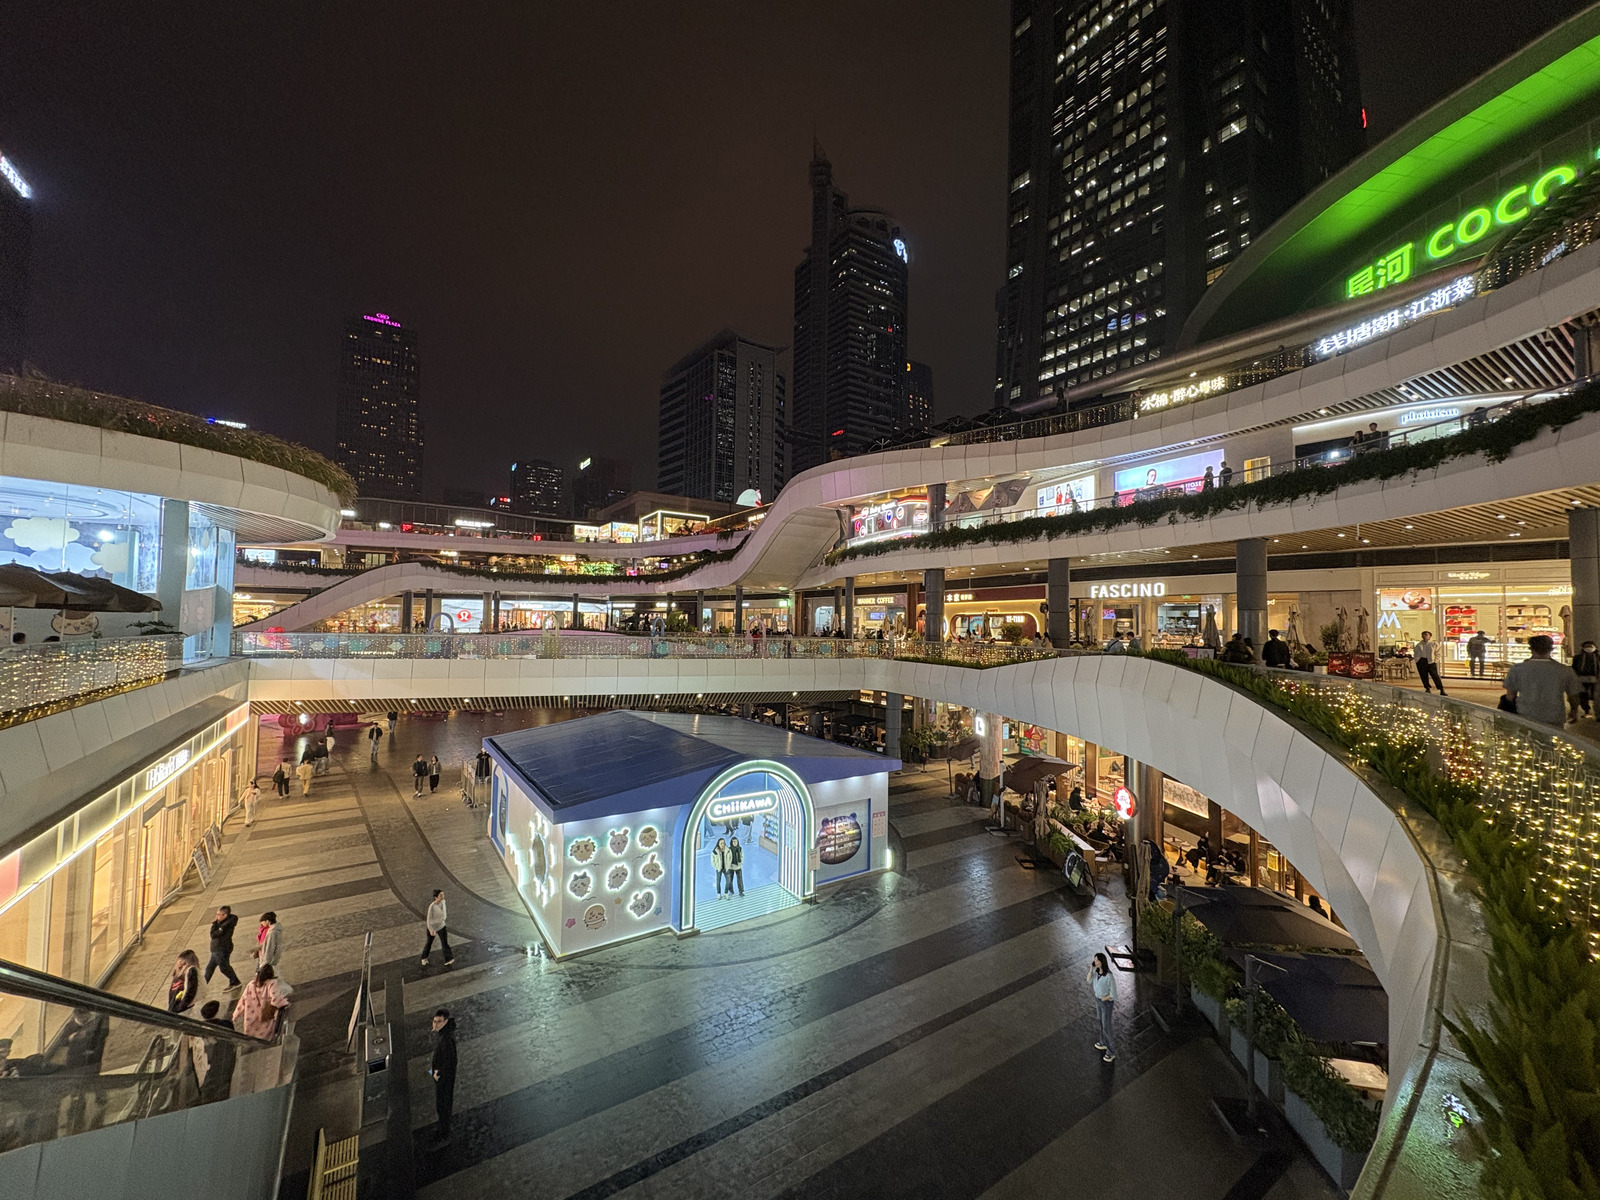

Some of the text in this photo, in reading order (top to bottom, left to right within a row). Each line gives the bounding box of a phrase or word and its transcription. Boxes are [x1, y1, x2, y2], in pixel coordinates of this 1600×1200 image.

[1401, 408, 1459, 424] photoism
[1091, 582, 1165, 598] FASCINO
[876, 596, 893, 604] COFFEE
